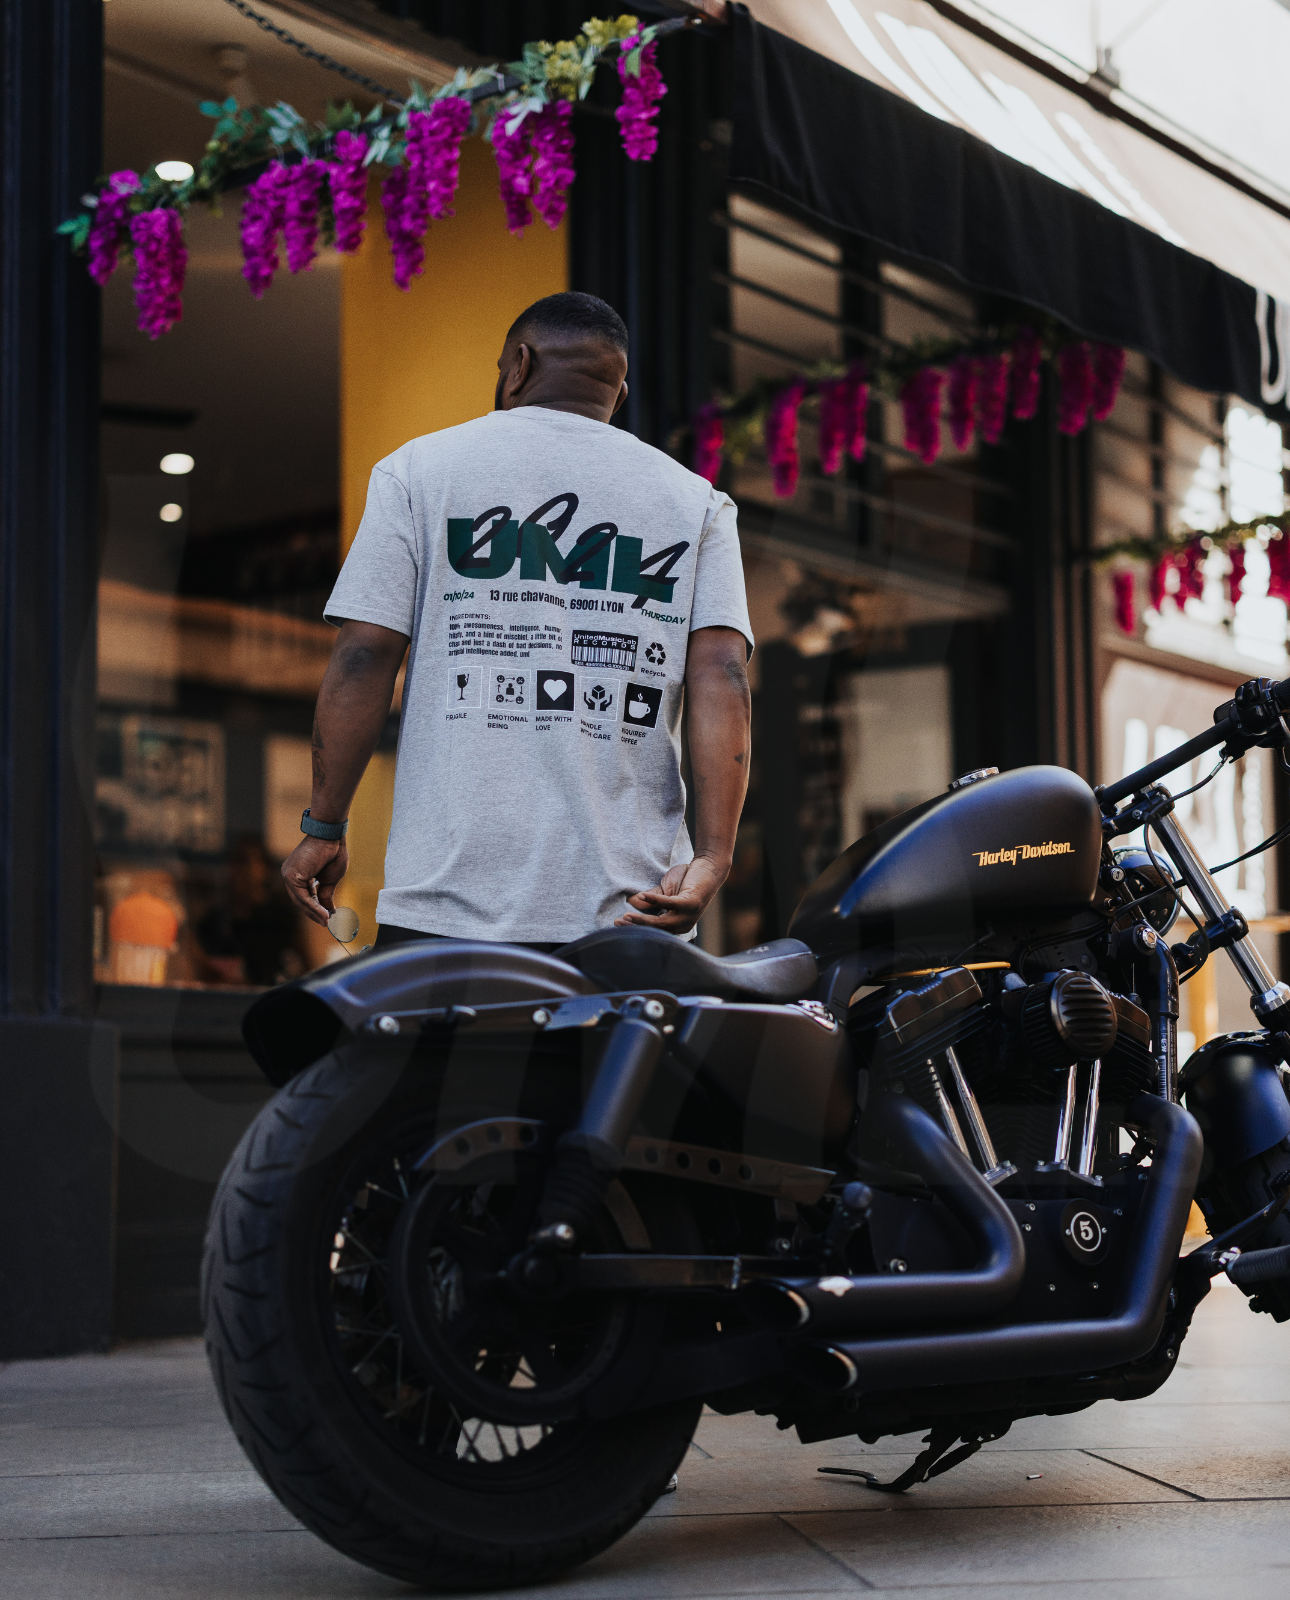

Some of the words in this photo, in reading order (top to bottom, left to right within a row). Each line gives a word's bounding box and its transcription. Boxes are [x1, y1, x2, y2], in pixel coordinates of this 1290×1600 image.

[489, 590, 500, 601] 13
[502, 590, 518, 601] rue
[521, 591, 567, 610] chavanne,
[570, 599, 598, 611] 69001
[600, 600, 624, 614] LYON
[641, 608, 686, 625] THURSDAY
[641, 667, 666, 678] Recycle
[487, 713, 528, 722] EMOTIONAL
[972, 841, 1075, 866] Harley-Davidson
[1079, 1220, 1094, 1241] 5
